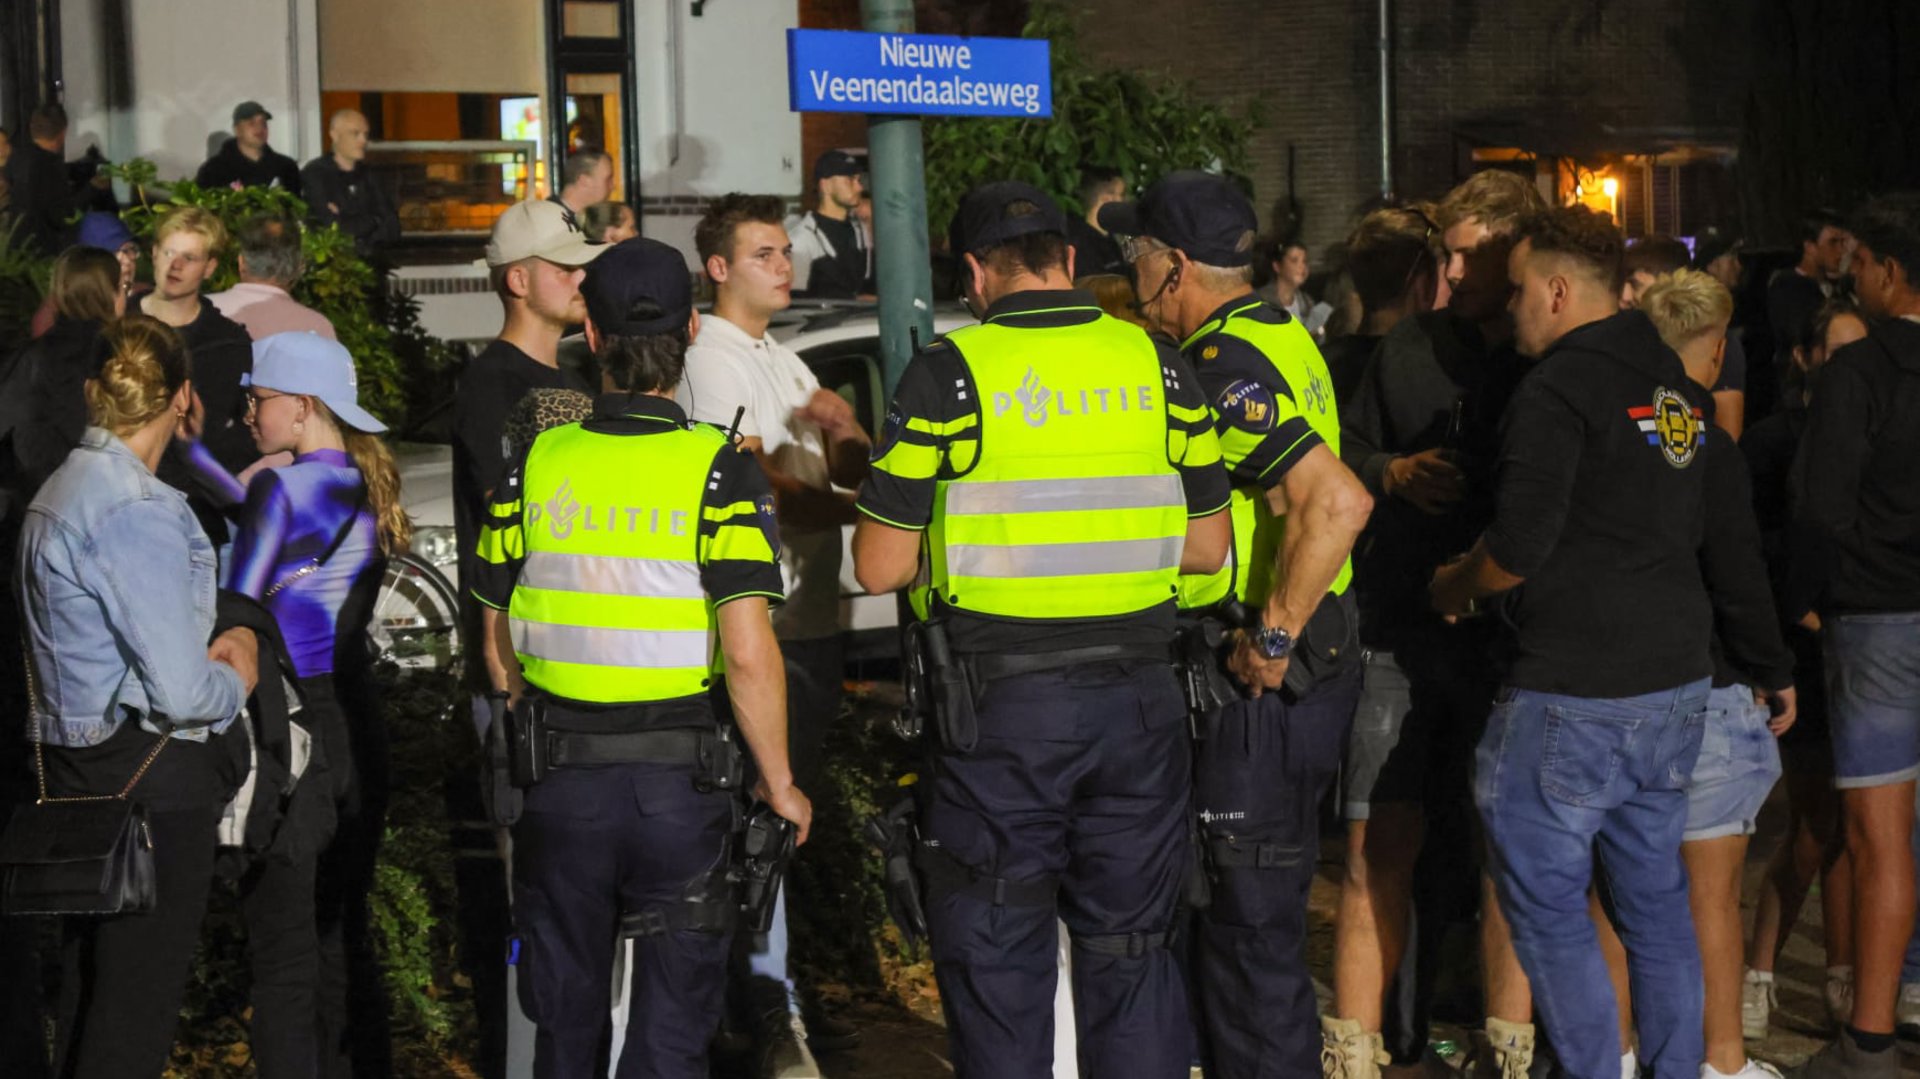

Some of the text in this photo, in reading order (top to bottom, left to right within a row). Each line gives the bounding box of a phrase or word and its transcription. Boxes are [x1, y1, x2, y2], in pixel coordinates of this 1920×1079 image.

[880, 36, 972, 69] Nieuwe
[810, 70, 1041, 113] Veenendaalseweg
[993, 376, 1154, 428] POLITIE
[528, 488, 688, 540] POLITIE
